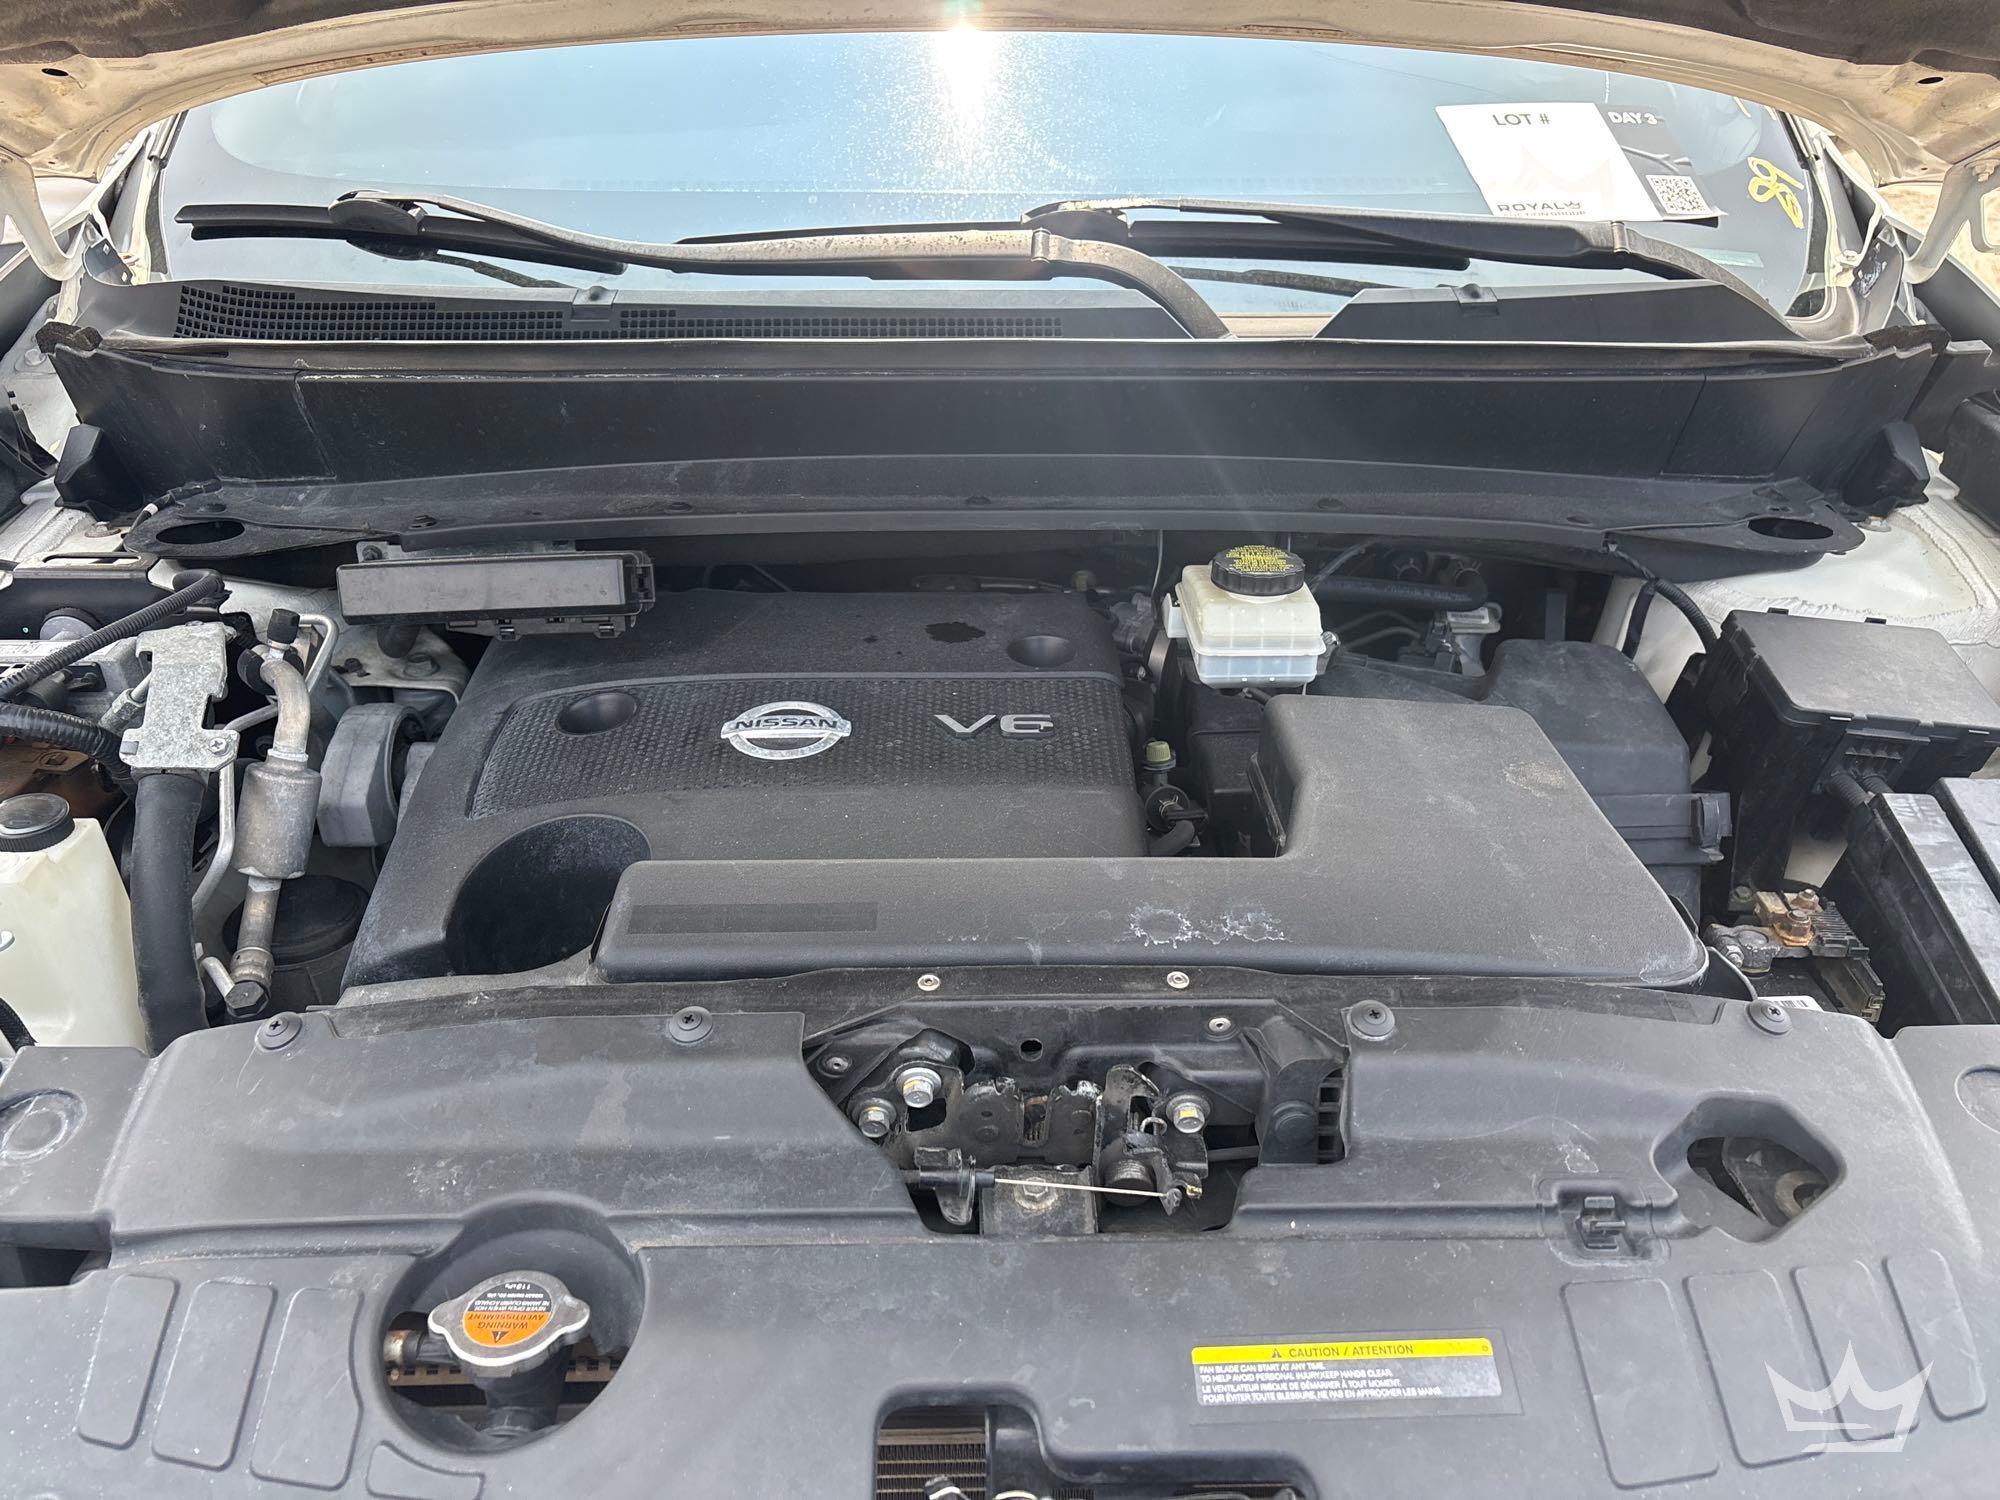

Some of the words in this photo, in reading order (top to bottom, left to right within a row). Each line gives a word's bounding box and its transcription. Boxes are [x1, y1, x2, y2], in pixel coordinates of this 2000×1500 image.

[1492, 113, 1532, 126] LOT
[1538, 112, 1551, 125] #
[1607, 111, 1643, 125] DAY
[1497, 202, 1566, 212] ROYAL
[734, 717, 839, 730] NISSAN
[934, 713, 1055, 739] V6
[467, 1313, 545, 1321] AVERTISSEMENT
[477, 1320, 529, 1330] WARNING
[1288, 1346, 1340, 1358] CAUTION
[1352, 1344, 1414, 1356] ATTENTION
[1199, 1365, 1215, 1374] FAN
[1215, 1364, 1240, 1374] BLADE
[1240, 1364, 1257, 1373] CAN
[1257, 1363, 1280, 1372] START
[1280, 1362, 1290, 1371] AT
[1290, 1362, 1306, 1371] ANY
[1200, 1374, 1212, 1383] TO
[1212, 1373, 1232, 1383] HELP
[1232, 1373, 1255, 1382] AVOID
[1255, 1371, 1296, 1382] PERSONAL
[1340, 1369, 1367, 1379] HANDS
[1202, 1384, 1212, 1394] LE
[1212, 1383, 1260, 1394] VENTILATEUR
[1260, 1381, 1288, 1392] RISQUE
[1288, 1382, 1299, 1391] DE
[1300, 1379, 1341, 1391] DÉMARRER
[1348, 1379, 1368, 1389] TOUT
[1202, 1394, 1225, 1404] POUR
[1251, 1391, 1276, 1402] TOUTE
[1317, 1390, 1329, 1400] NE
[1328, 1389, 1344, 1399] PAS
[1344, 1389, 1356, 1399] EN
[1356, 1387, 1402, 1399] APPROCHER
[1402, 1387, 1417, 1397] LES
